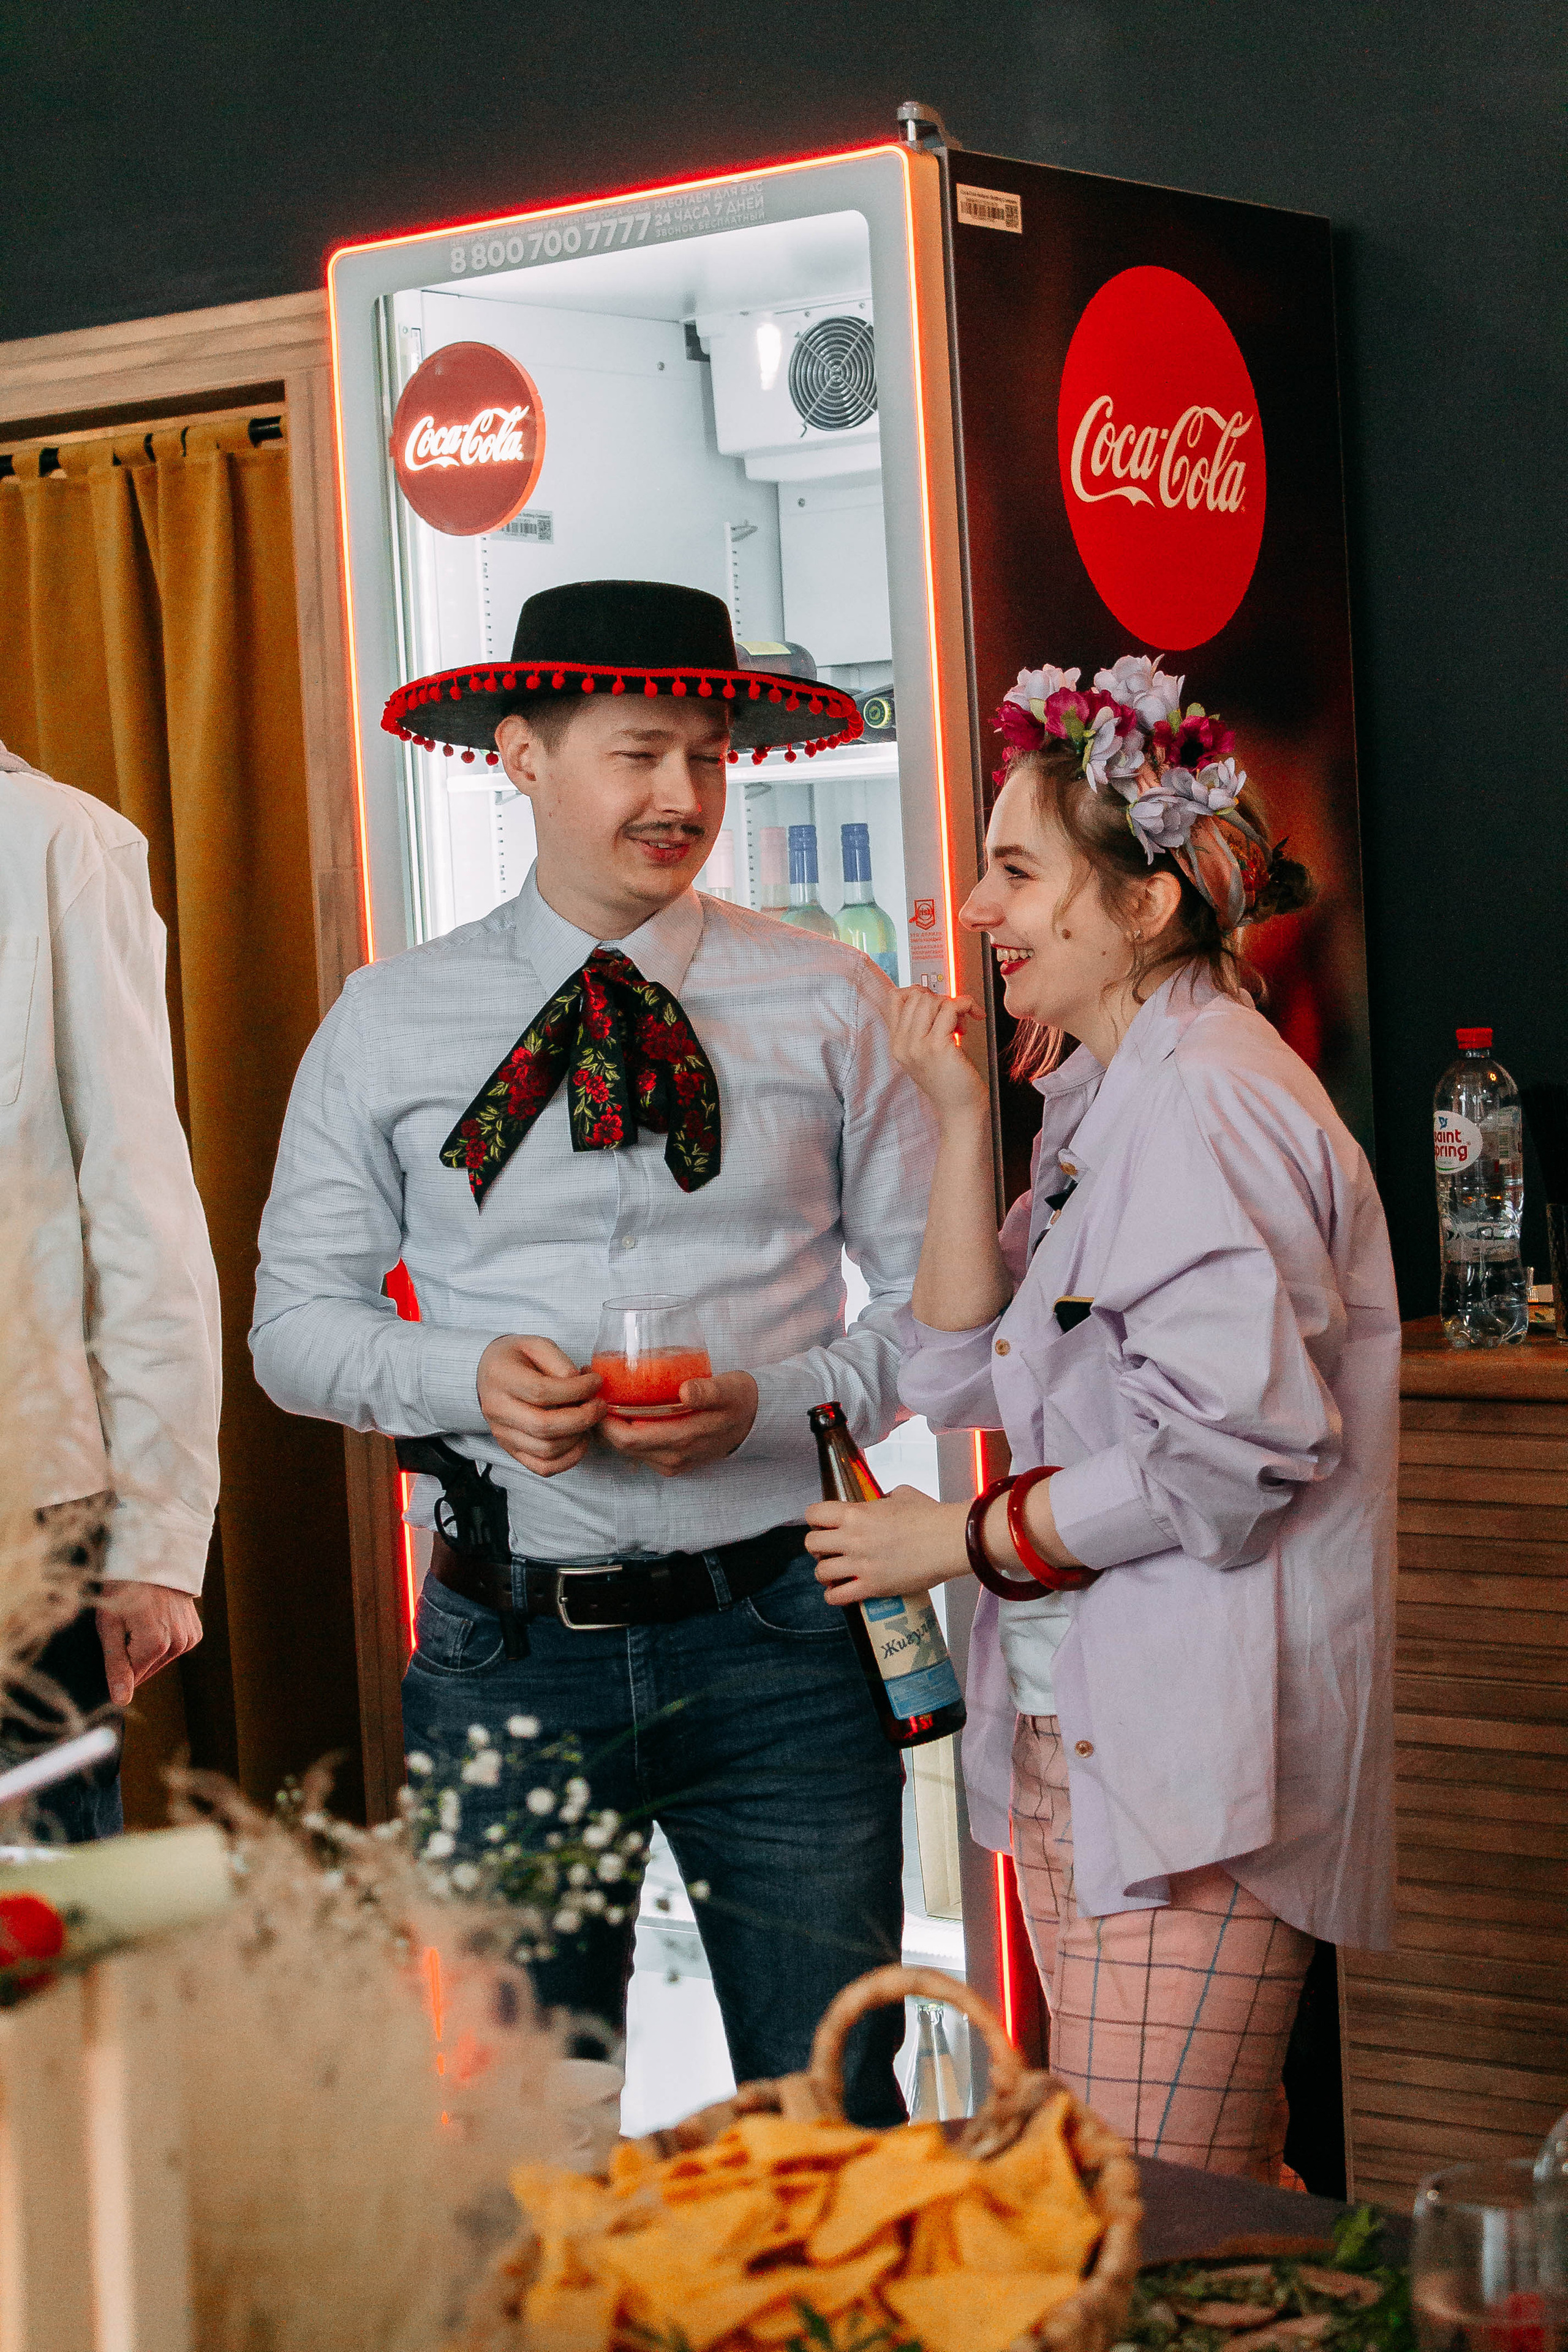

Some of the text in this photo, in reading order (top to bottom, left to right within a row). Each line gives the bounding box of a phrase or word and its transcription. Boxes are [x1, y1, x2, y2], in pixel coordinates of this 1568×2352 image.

[655, 181, 764, 209] РАБОТАЕМ ДЛЯ ВАС
[655, 194, 764, 227] 24 ЧАСА 7 ДНЕЙ
[655, 211, 765, 237] ЗВОНОК БЕСПЛАТНЫЙ
[450, 211, 651, 273] 8 800 700 7777
[405, 405, 530, 471] Coca-Cola
[1071, 395, 1253, 513] Coca-Cola
[1434, 1145, 1468, 1161] pring
